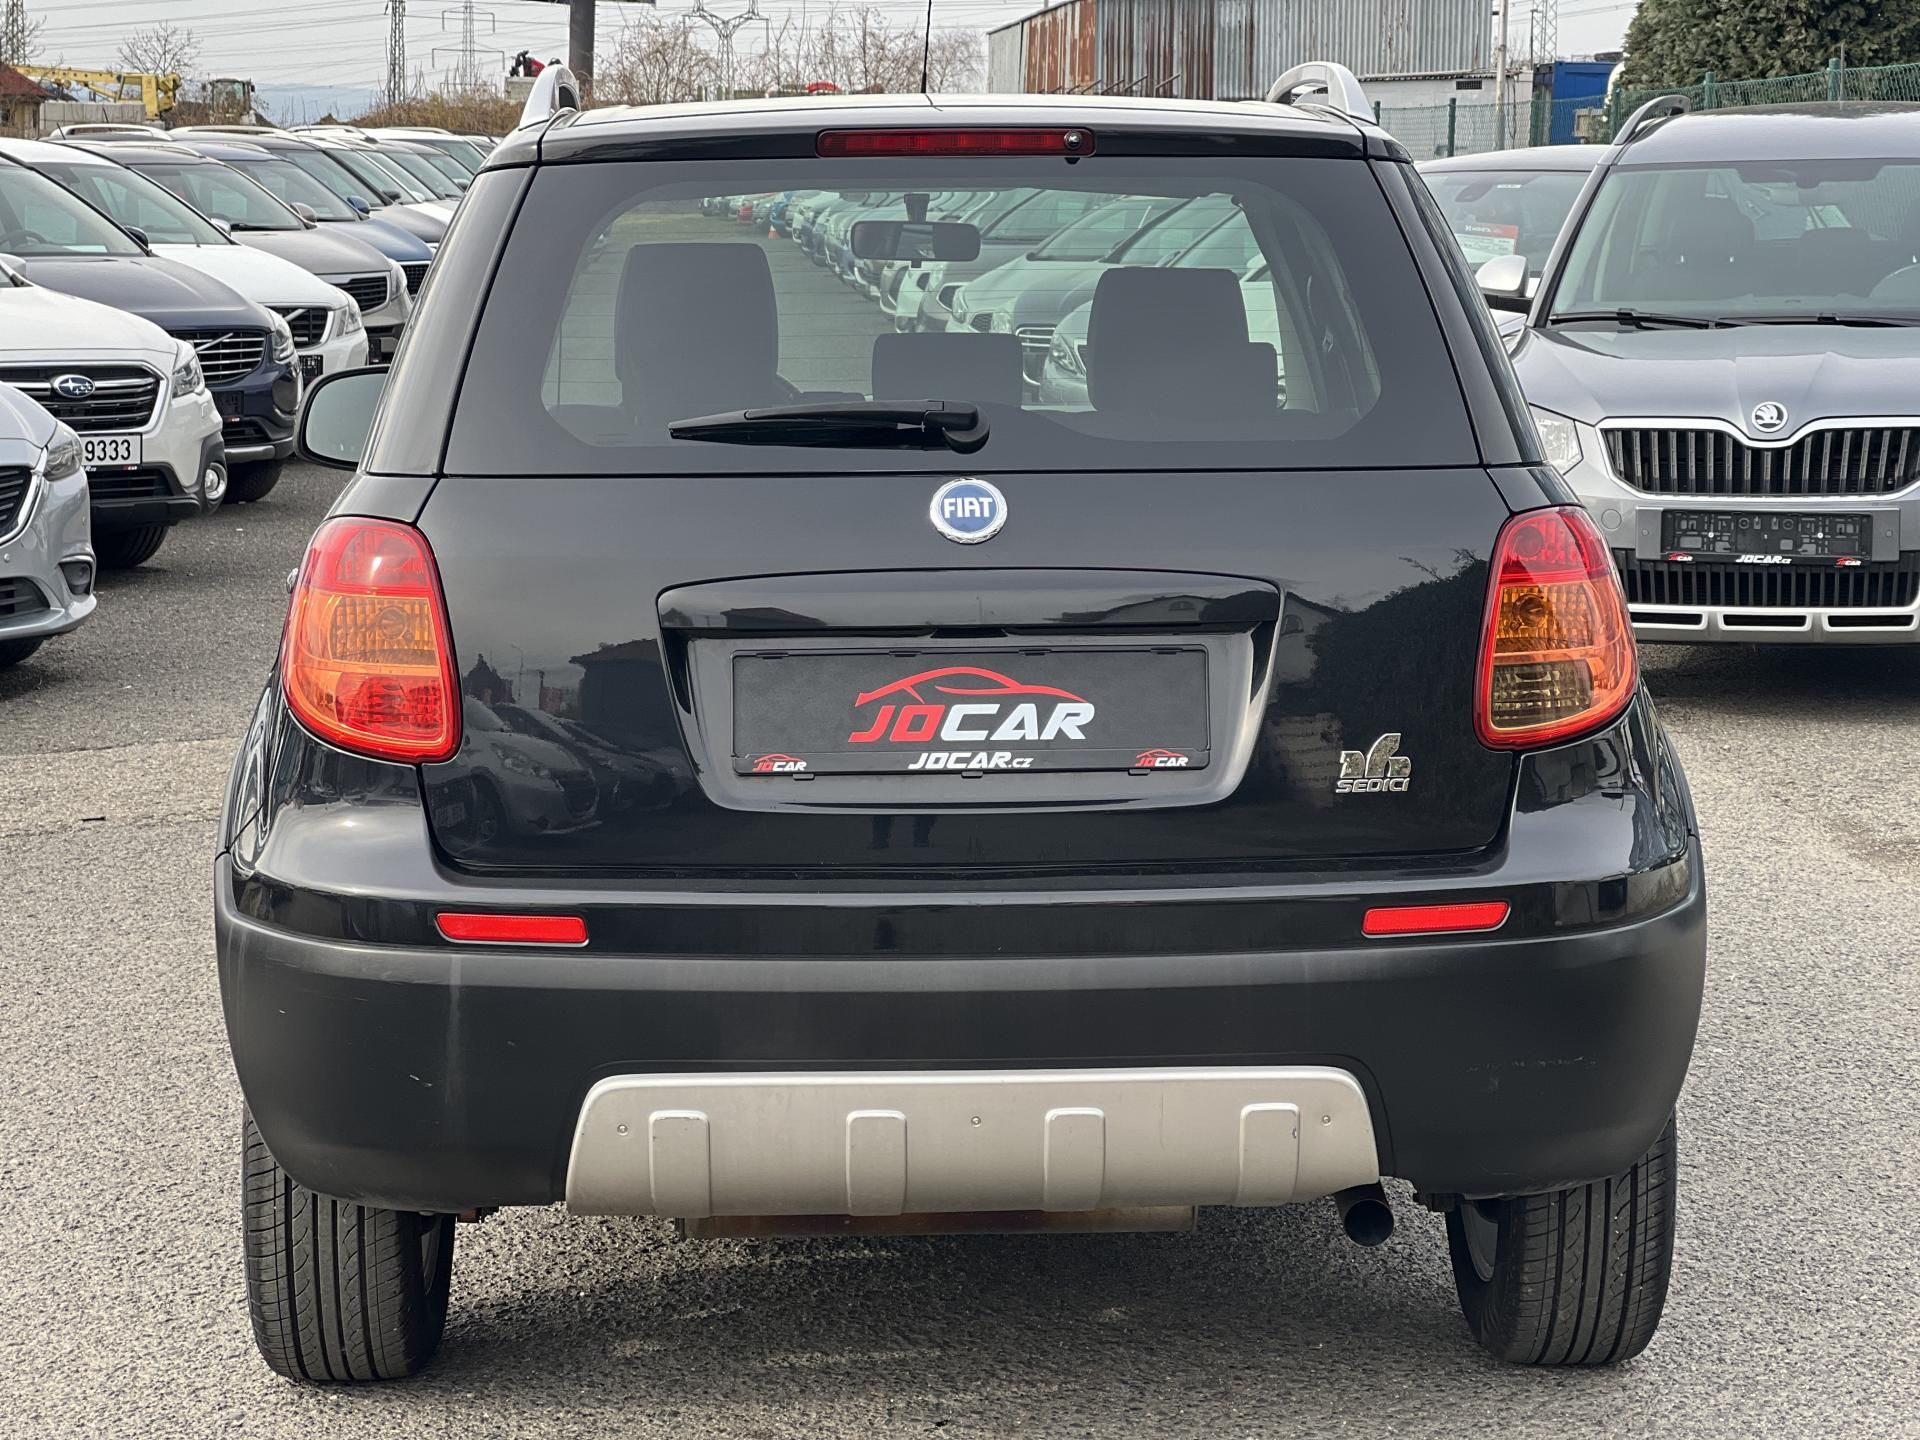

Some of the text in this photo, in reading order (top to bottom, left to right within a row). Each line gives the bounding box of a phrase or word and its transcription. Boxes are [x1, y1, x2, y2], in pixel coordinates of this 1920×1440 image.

[84, 439, 131, 462] 9333
[943, 497, 993, 519] FIAT
[847, 703, 1096, 743] JOCAR
[752, 761, 808, 772] JOCAR
[1135, 756, 1189, 768] JOCAR
[1335, 777, 1411, 794] SEDICI
